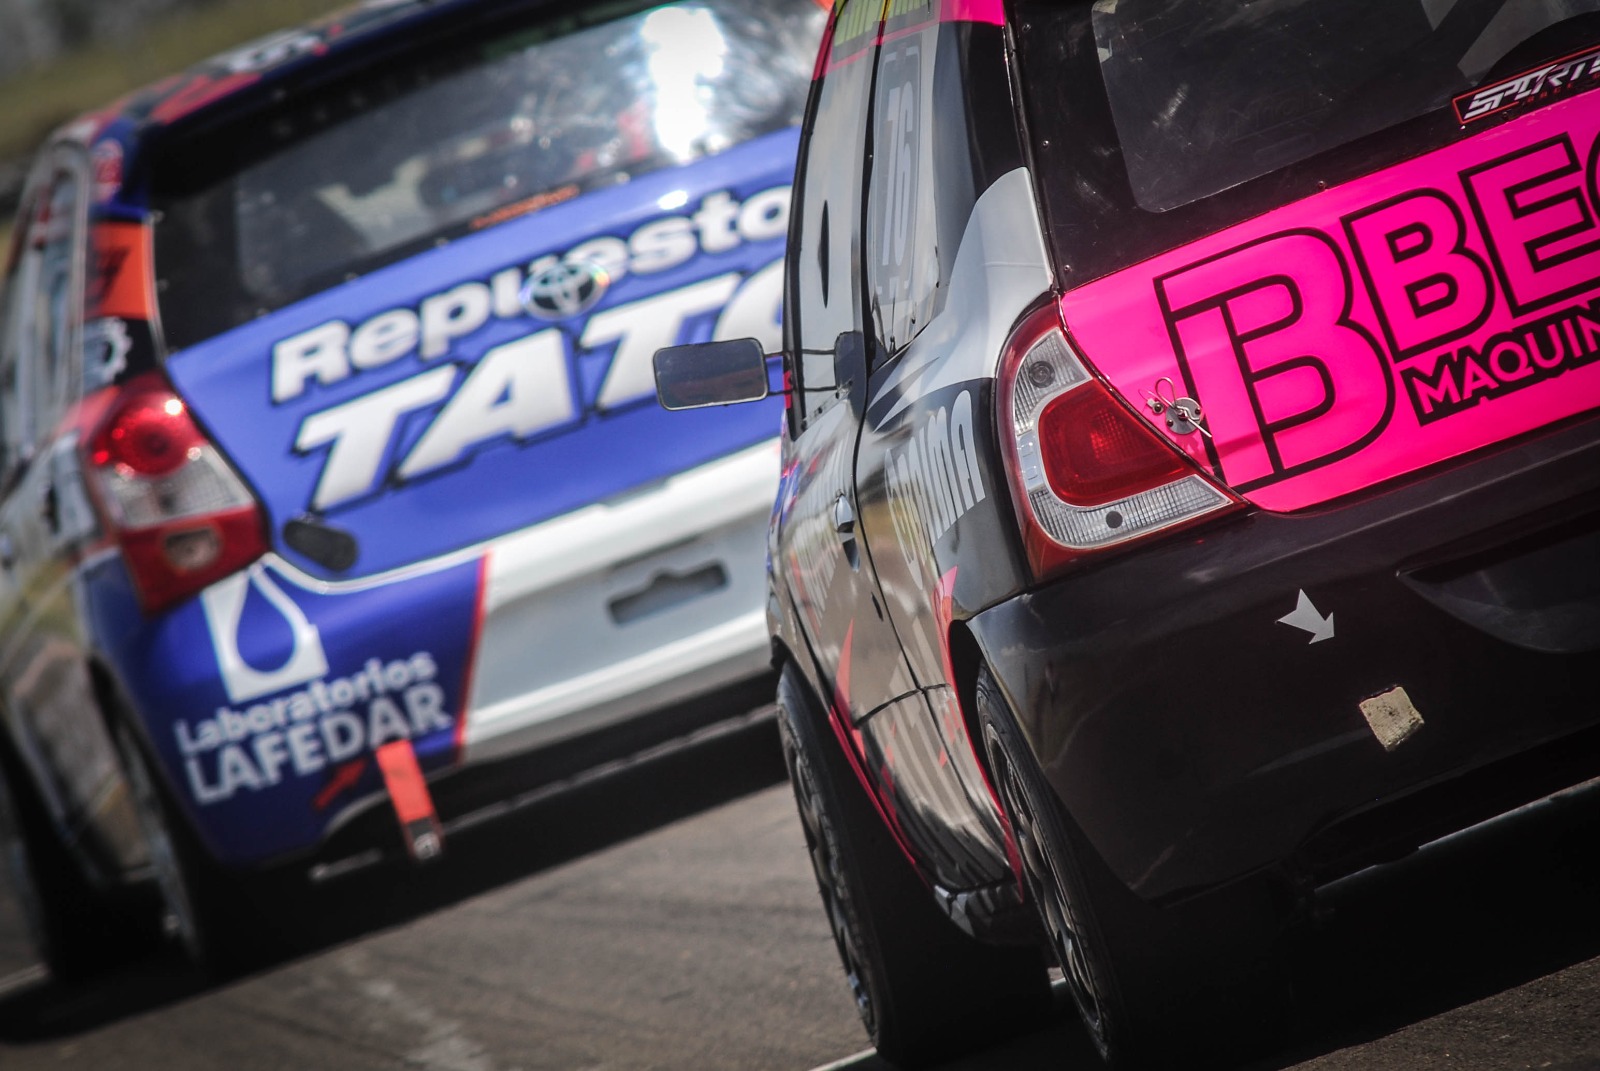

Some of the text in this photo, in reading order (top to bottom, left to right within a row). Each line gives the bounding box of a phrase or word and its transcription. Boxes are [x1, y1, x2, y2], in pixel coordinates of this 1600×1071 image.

[882, 81, 914, 266] 76
[1338, 132, 1600, 363] BE
[175, 652, 438, 754] Laboratorios
[187, 685, 454, 803] LAFEDAR
